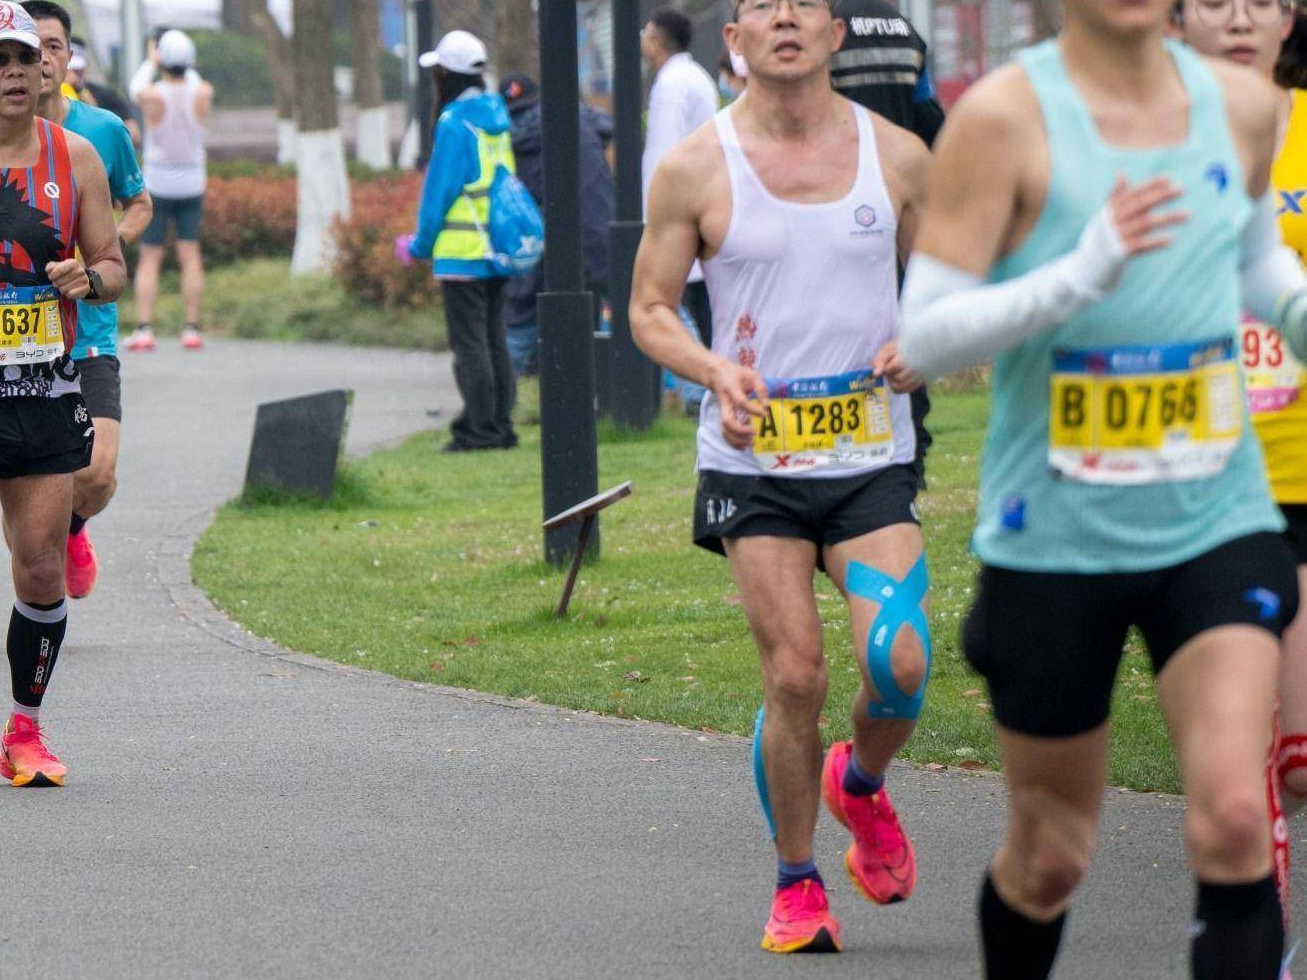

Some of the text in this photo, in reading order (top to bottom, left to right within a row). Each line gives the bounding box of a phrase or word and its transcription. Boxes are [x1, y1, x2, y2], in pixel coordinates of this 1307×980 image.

[760, 398, 860, 438] A 1283
[1061, 384, 1085, 429] B
